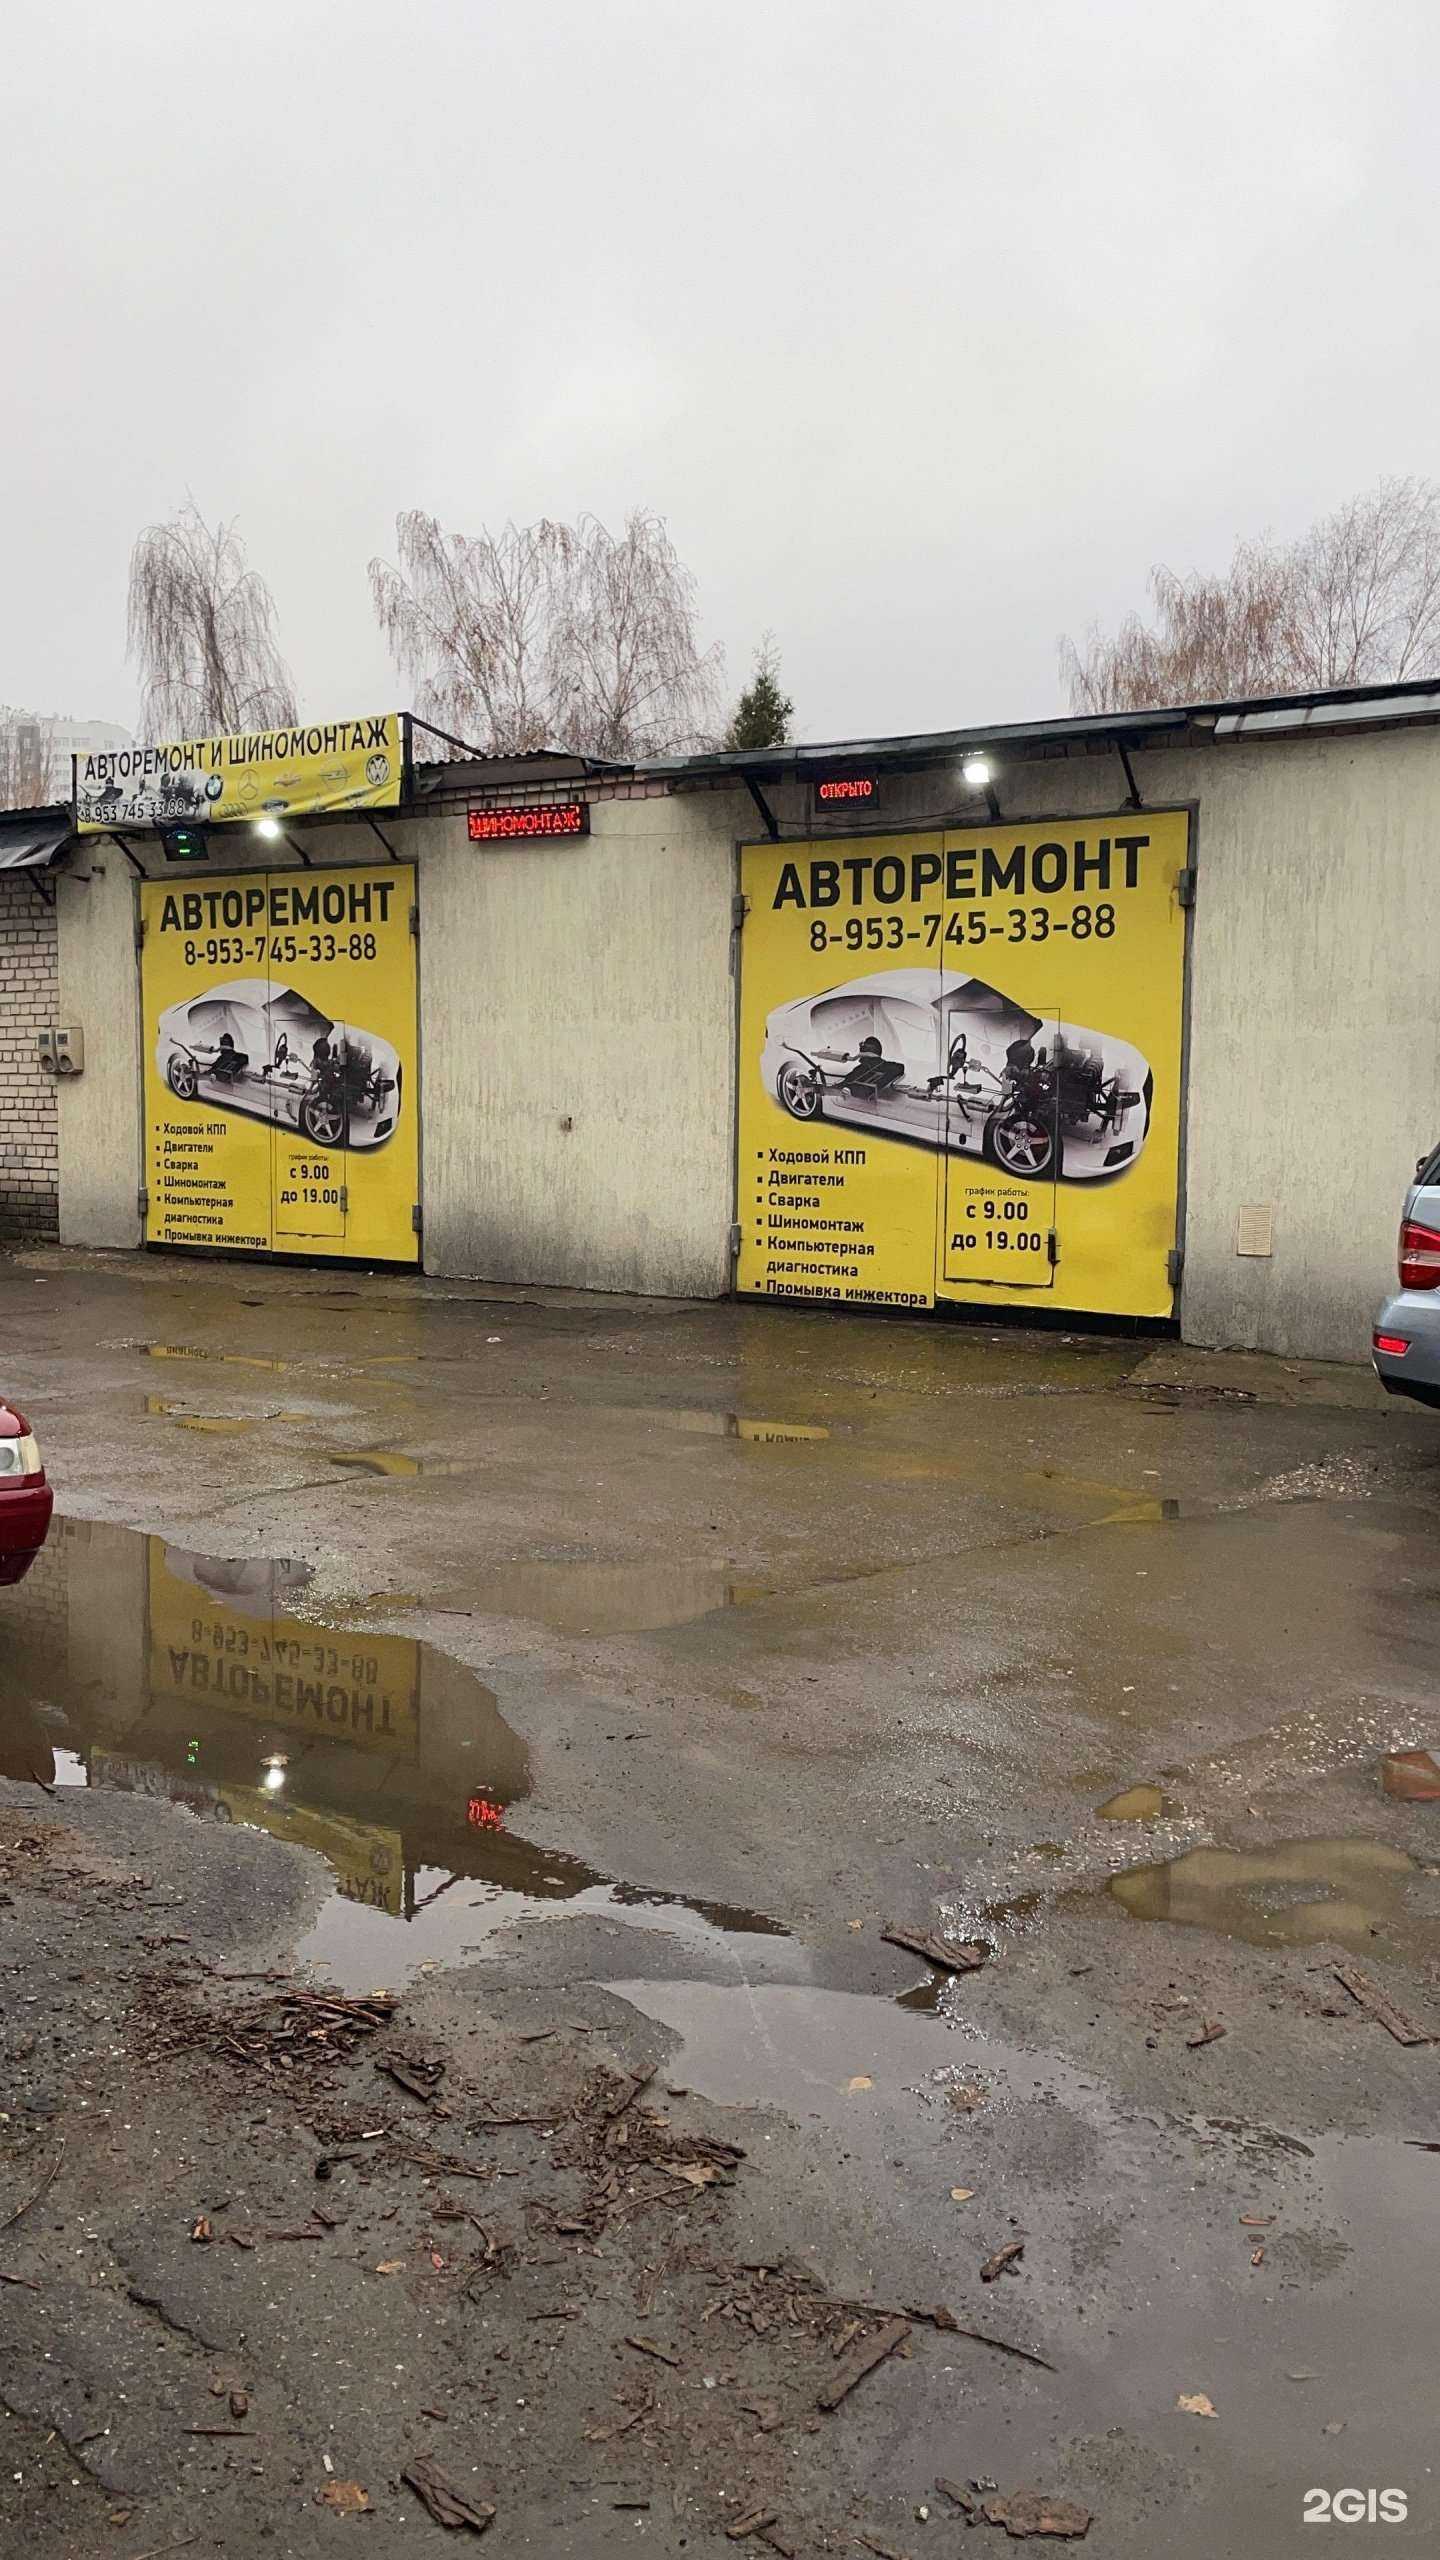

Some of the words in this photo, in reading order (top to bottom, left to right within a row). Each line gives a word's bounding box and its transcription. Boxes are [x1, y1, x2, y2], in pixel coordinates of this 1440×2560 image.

[84, 743, 205, 782] АВТОРЕМОНТ
[210, 747, 223, 767] И
[229, 718, 389, 766] ШИНОМОНТАЖ
[820, 780, 872, 799] ОТКРЫТО
[95, 805, 118, 822] 953
[122, 801, 144, 820] 745
[149, 801, 165, 818] 33
[167, 799, 185, 816] 88
[471, 812, 576, 833] ШИНОМОНТАЖ
[772, 835, 1151, 911] АВТОРЕМОНТ
[160, 881, 395, 932] АВТОРЕМОНТ
[809, 903, 1116, 953] 8-953-745-33-88
[184, 933, 377, 966] 8-953-745-33-88
[163, 1122, 204, 1135] Ходовой
[206, 1124, 227, 1135] КПП
[163, 1142, 213, 1154] Двигатели
[768, 1148, 829, 1166] Ходовой
[835, 1149, 866, 1165] КПП
[164, 1160, 199, 1172] Сварка
[290, 1168, 297, 1179] с
[300, 1164, 329, 1180] 9.00
[164, 1177, 226, 1189] Шиномонтаж
[768, 1171, 844, 1188] Двигатели
[164, 1194, 233, 1209] Компьютерная
[280, 1191, 297, 1204] до
[302, 1188, 338, 1204] 19.00
[768, 1193, 820, 1209] Сварка
[965, 1188, 995, 1197] график
[164, 1213, 224, 1225] диагностика
[966, 1205, 976, 1218] с
[984, 1201, 1028, 1220] 9.00
[768, 1215, 864, 1232] Шиномонтаж
[164, 1229, 213, 1243] Промывка
[215, 1234, 267, 1247] инжектора
[768, 1236, 875, 1257] Компьютерная
[951, 1234, 976, 1251] до
[986, 1231, 1041, 1251] 19.00
[766, 1261, 859, 1278] диагностика
[766, 1279, 841, 1300] Промывка
[845, 1287, 928, 1307] инжектора
